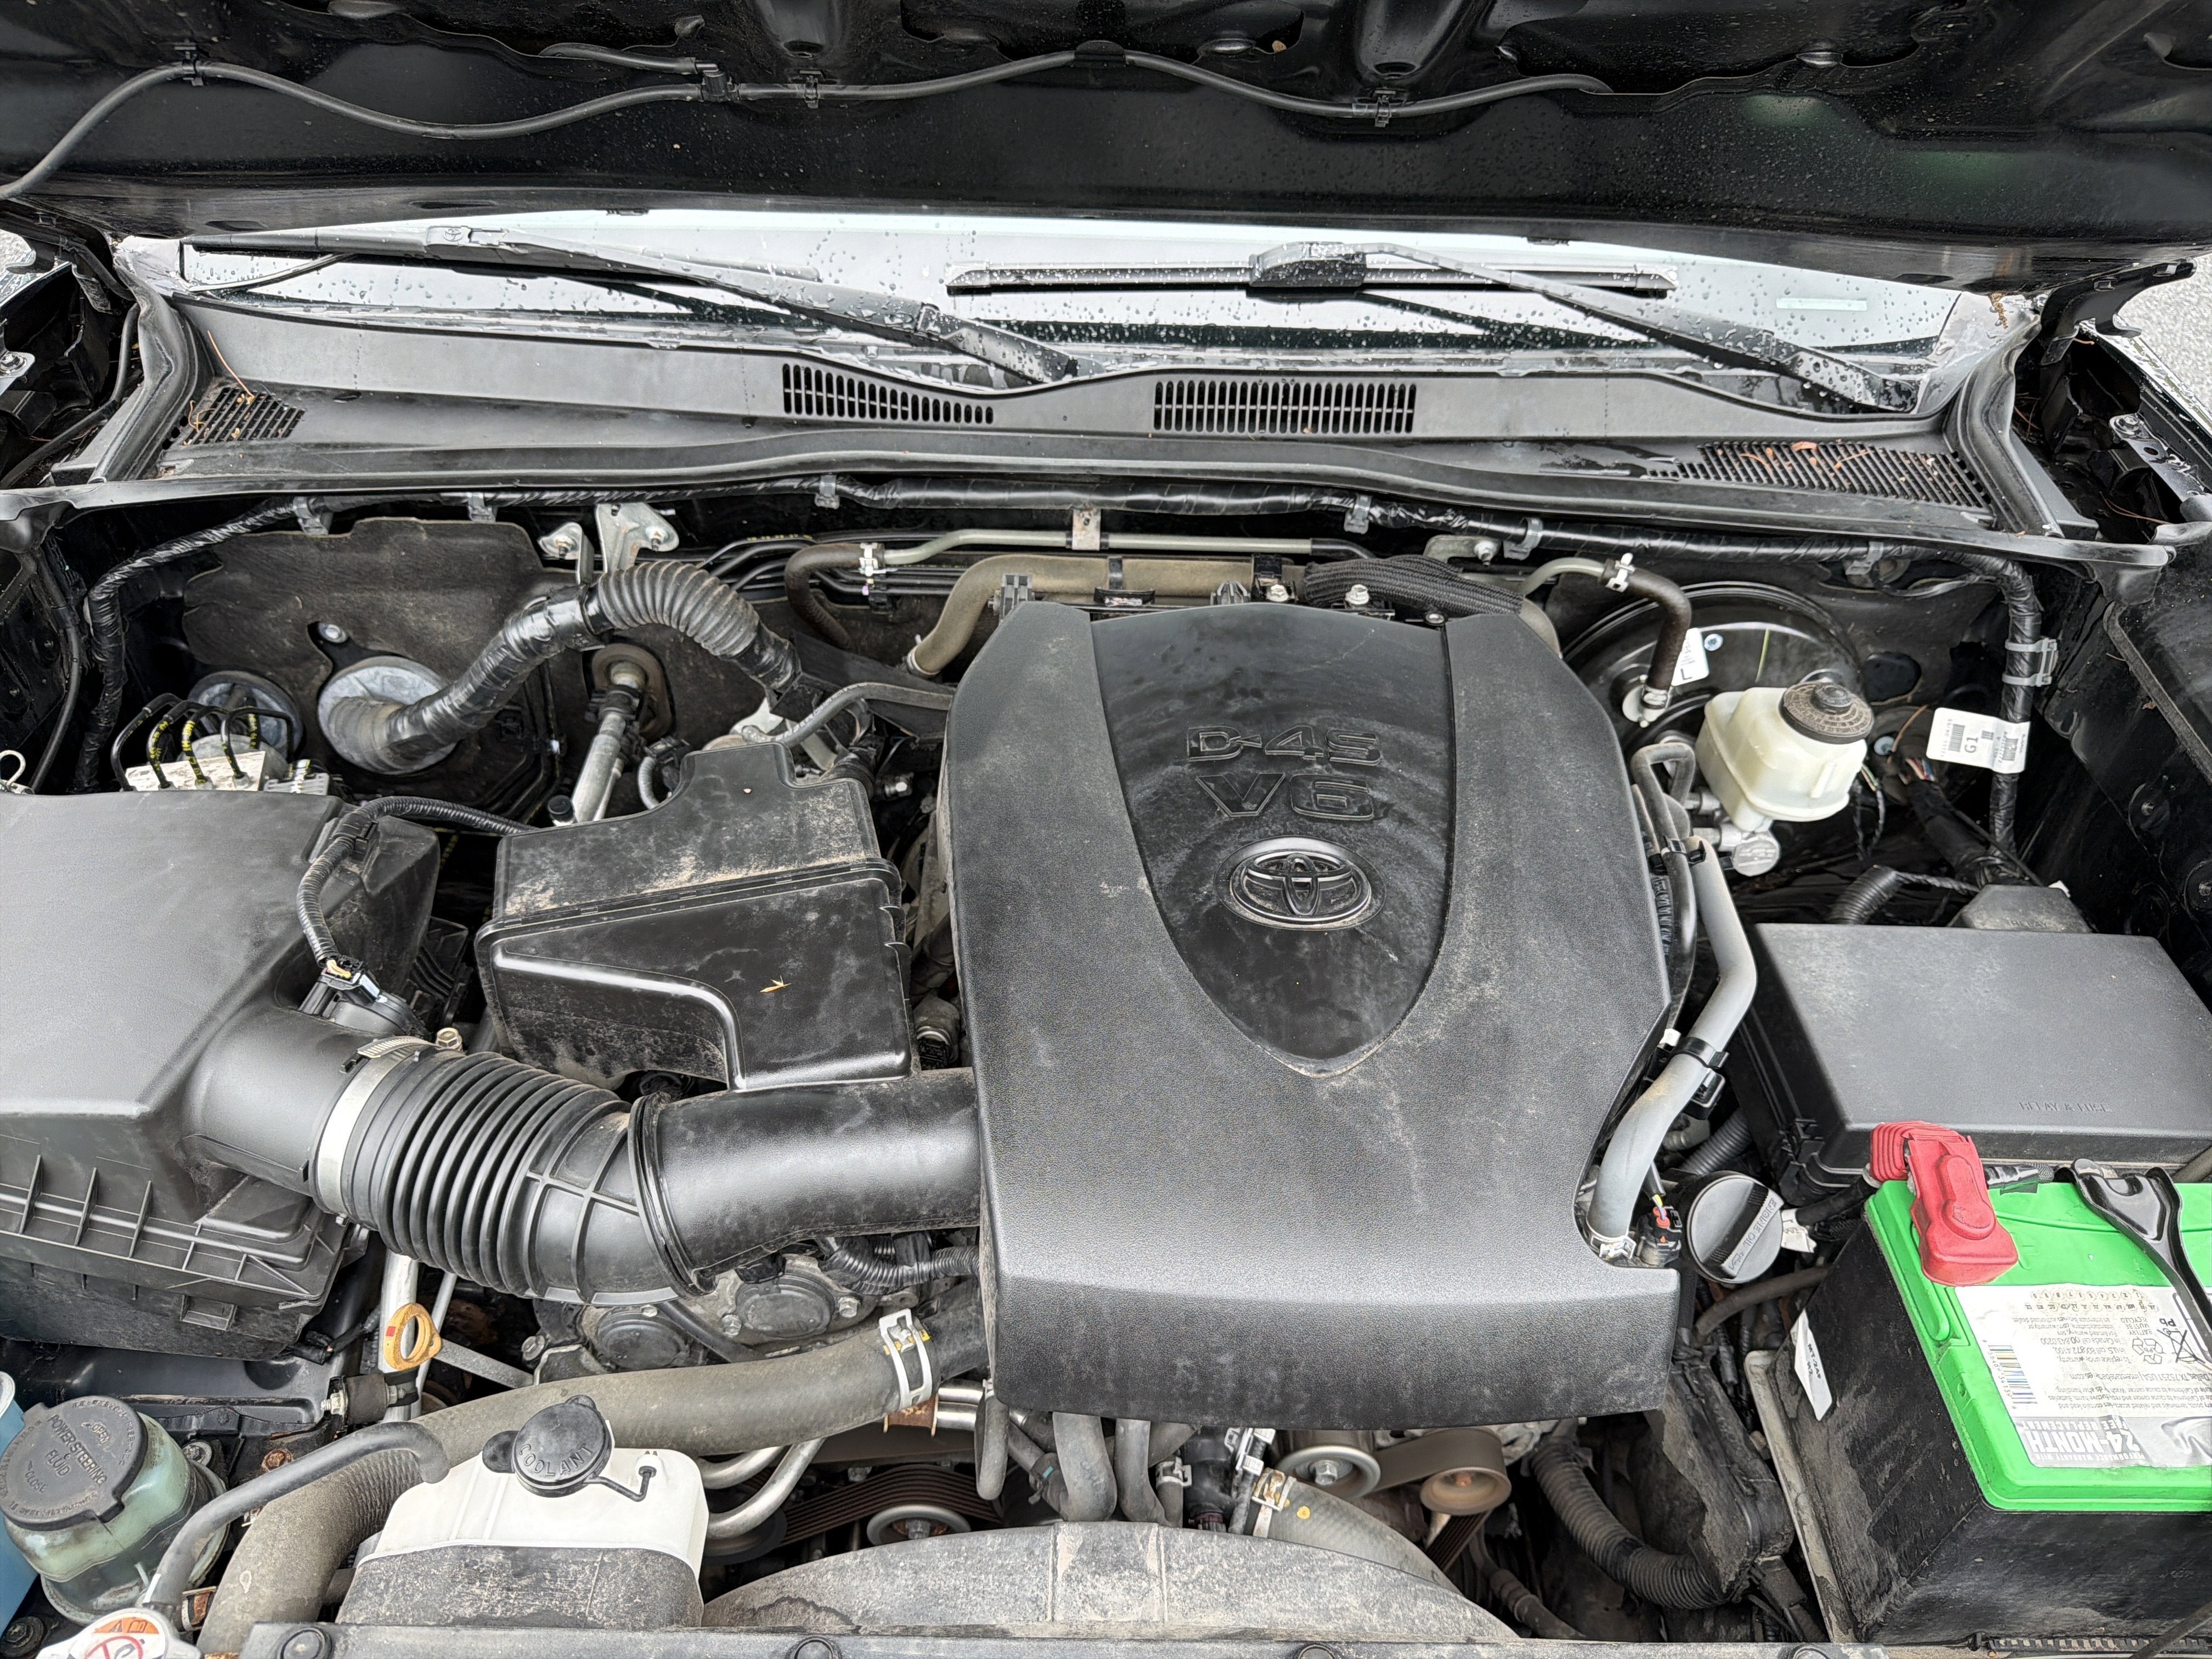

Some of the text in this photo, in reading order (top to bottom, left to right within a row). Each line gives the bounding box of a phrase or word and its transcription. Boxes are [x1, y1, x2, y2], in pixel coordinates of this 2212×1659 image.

[1187, 725, 1381, 766] D-4S
[1964, 737, 1978, 753] G1
[1195, 772, 1374, 821] V6
[1742, 1198, 1777, 1247] ENGINE OIL
[2159, 1318, 2177, 1327] Pb
[2158, 1373, 2180, 1381] 75251
[2179, 1373, 2190, 1381] TX
[91, 1423, 110, 1444] OPEN
[2020, 1420, 2100, 1431] REPLACEMENT
[47, 1414, 77, 1447] POWER
[70, 1442, 108, 1485] STEERING
[2026, 1428, 2141, 1453] 24-MONTH
[44, 1448, 71, 1477] FLUID
[518, 1443, 594, 1477] COOLANT
[24, 1470, 49, 1494] CLOSE
